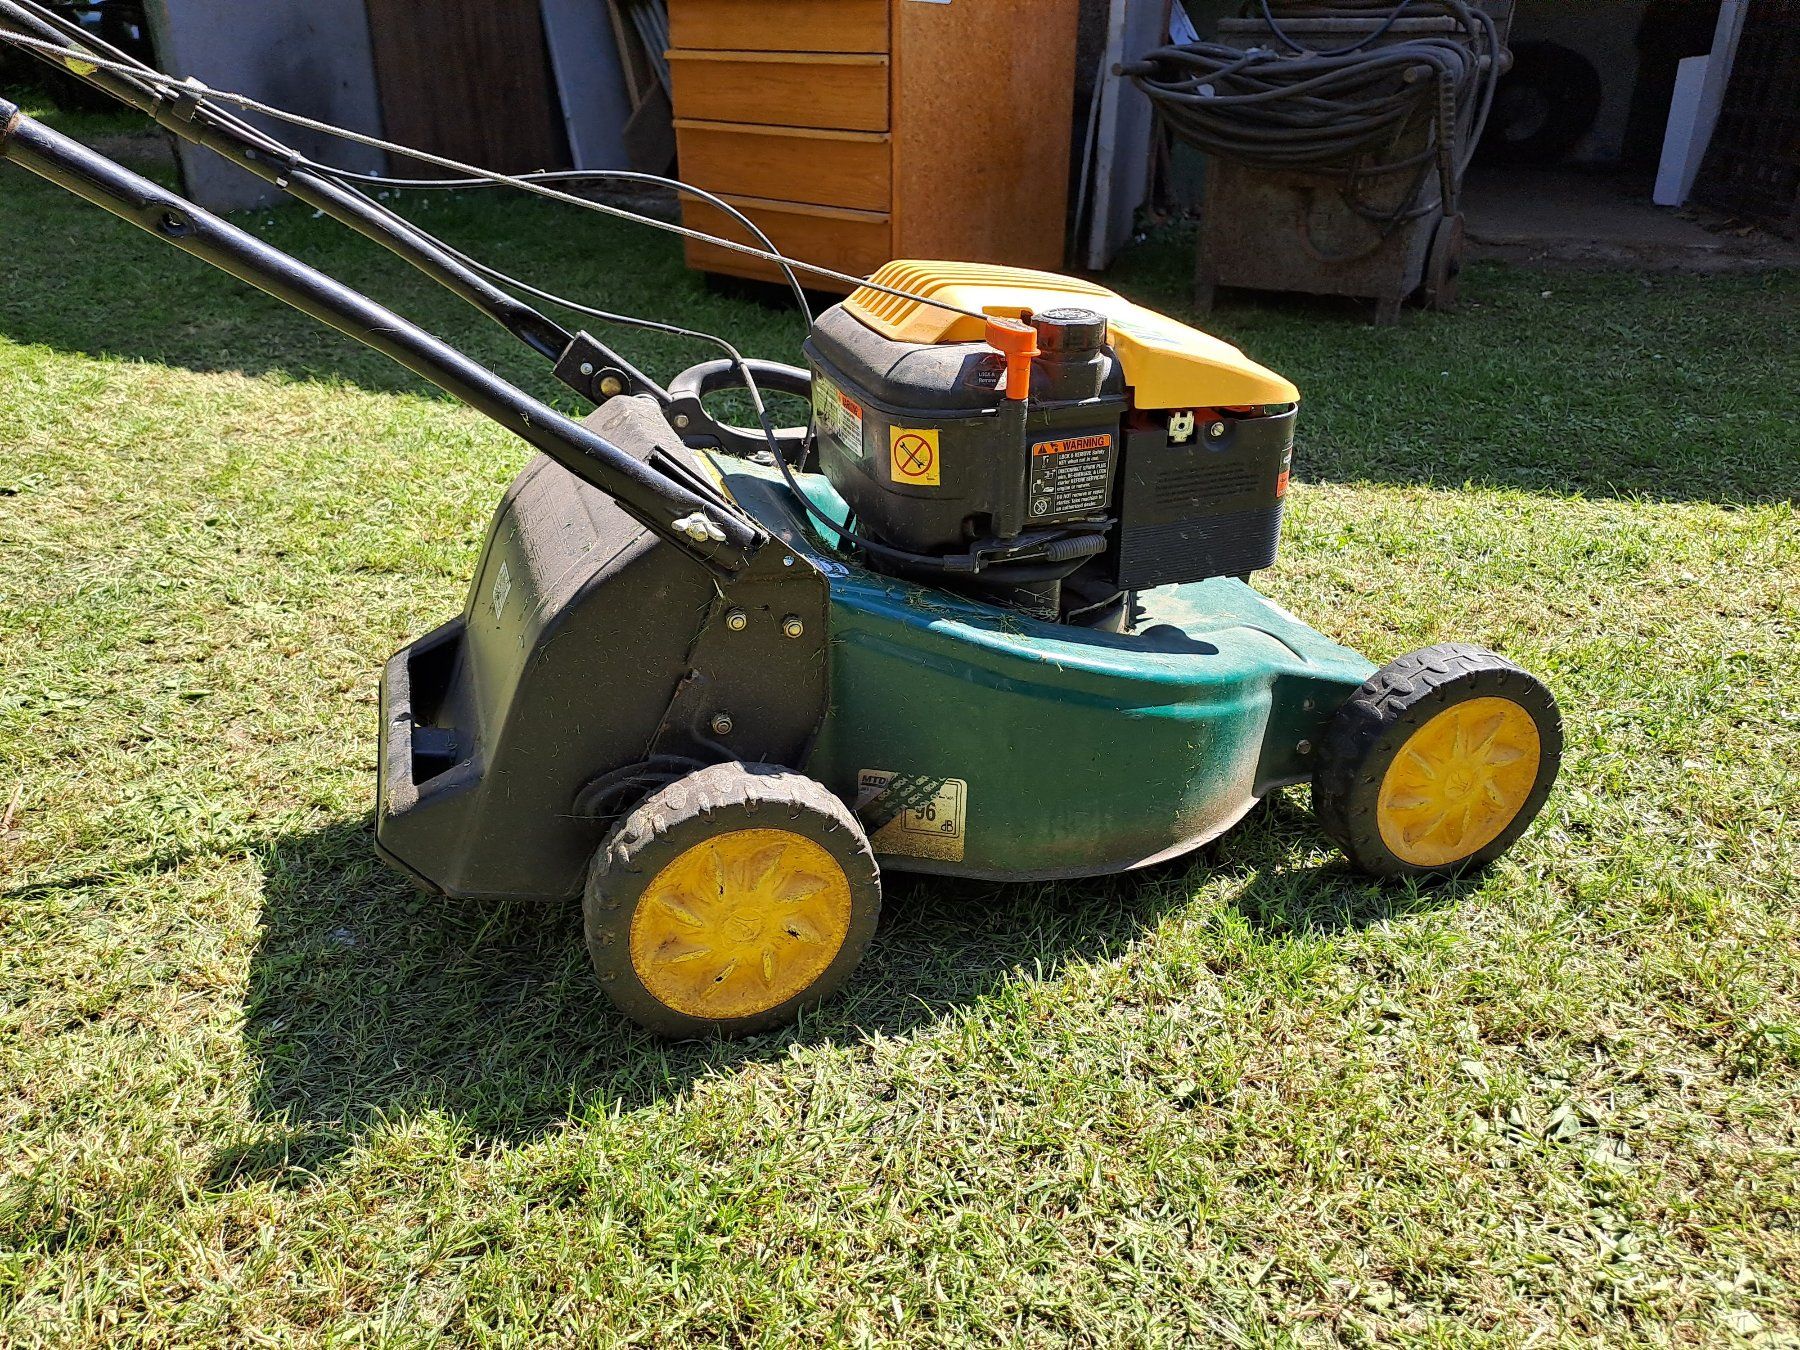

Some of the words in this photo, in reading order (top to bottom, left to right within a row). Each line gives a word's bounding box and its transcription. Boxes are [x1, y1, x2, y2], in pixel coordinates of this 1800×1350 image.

[1063, 437, 1104, 450] WARNING
[861, 775, 886, 784] MTD
[915, 802, 936, 821] 96
[941, 820, 954, 832] dB
